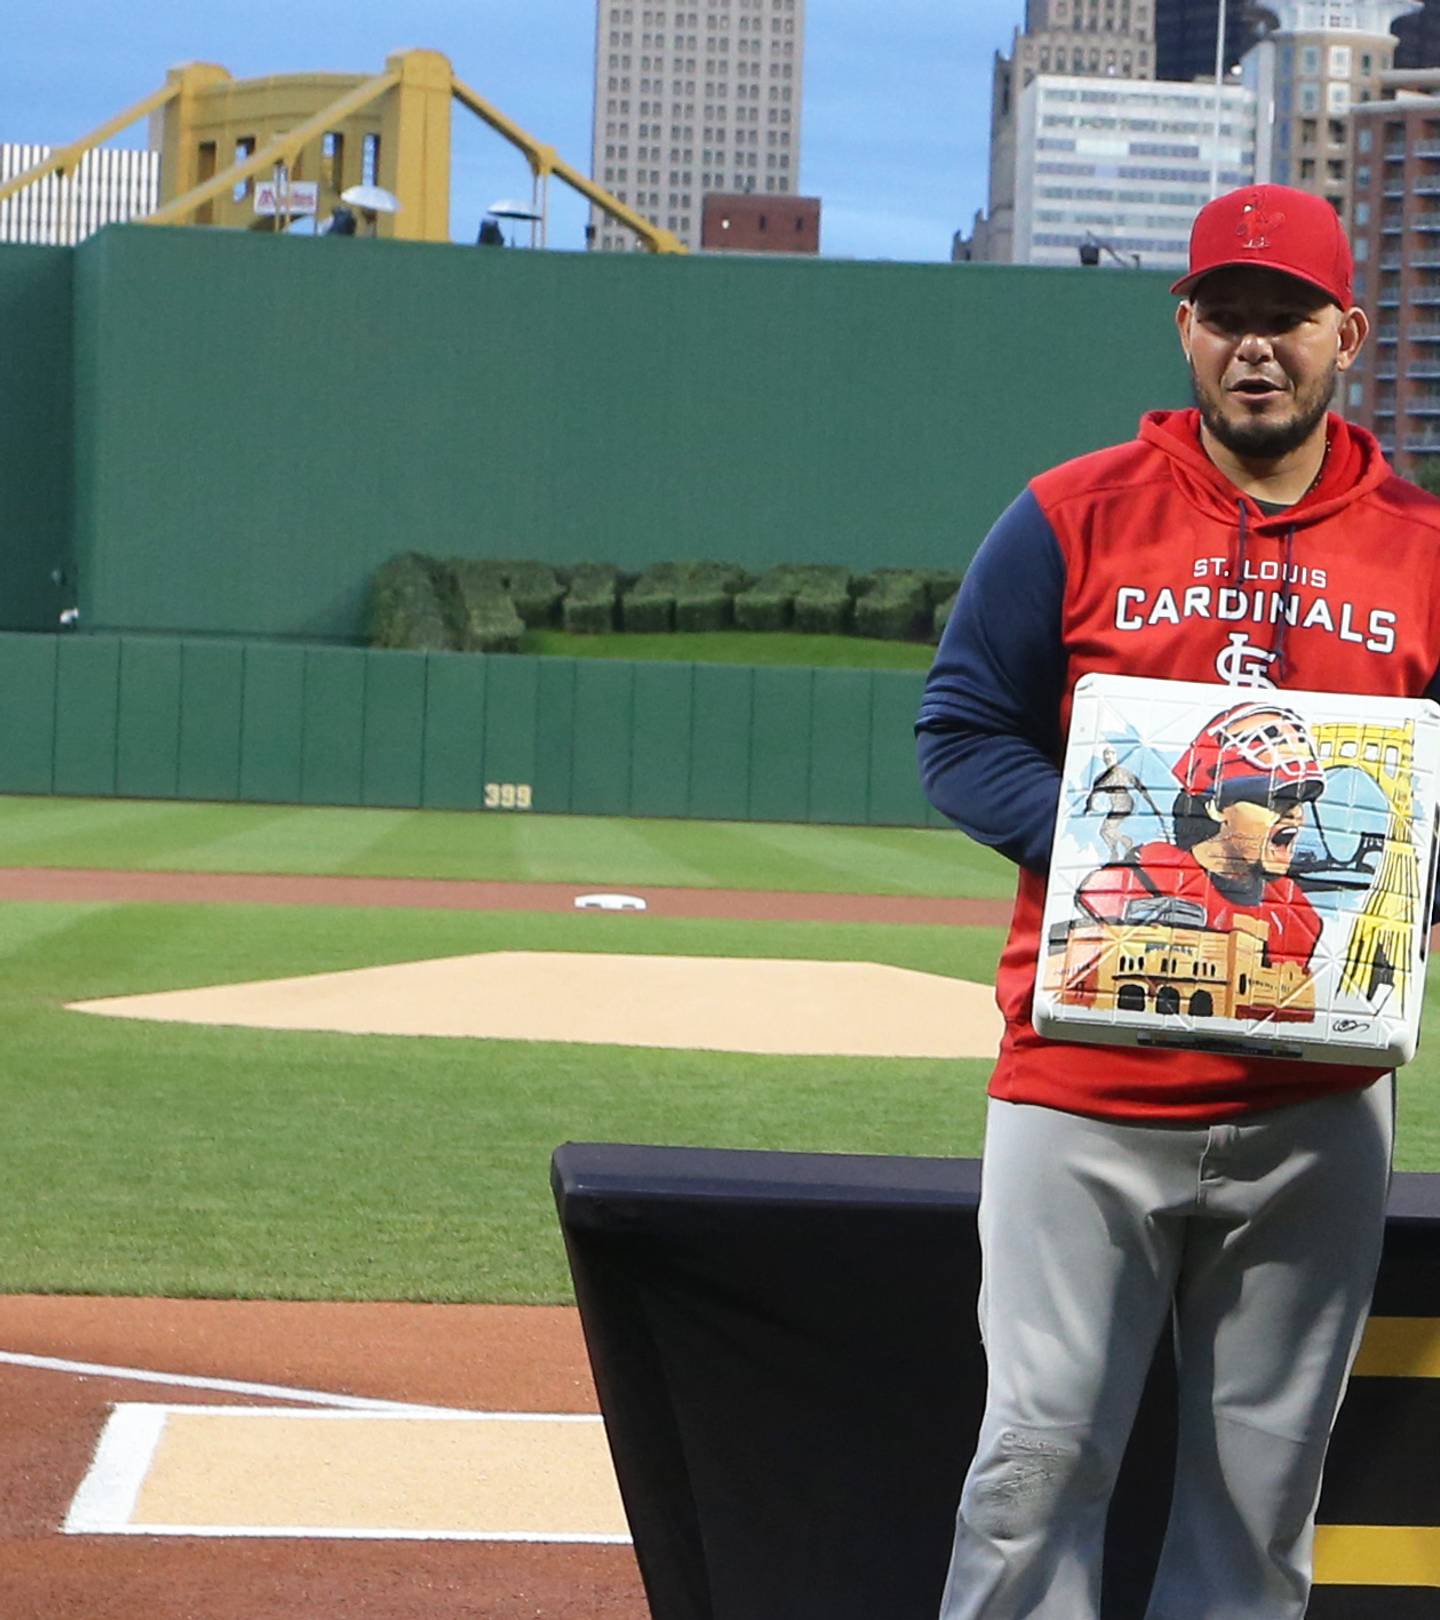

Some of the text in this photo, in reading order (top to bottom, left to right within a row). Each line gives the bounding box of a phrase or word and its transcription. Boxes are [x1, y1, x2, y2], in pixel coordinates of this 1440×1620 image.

[1193, 557, 1328, 589] ST. LOUIS
[1114, 585, 1397, 655] CARDINALS
[484, 783, 533, 809] 399
